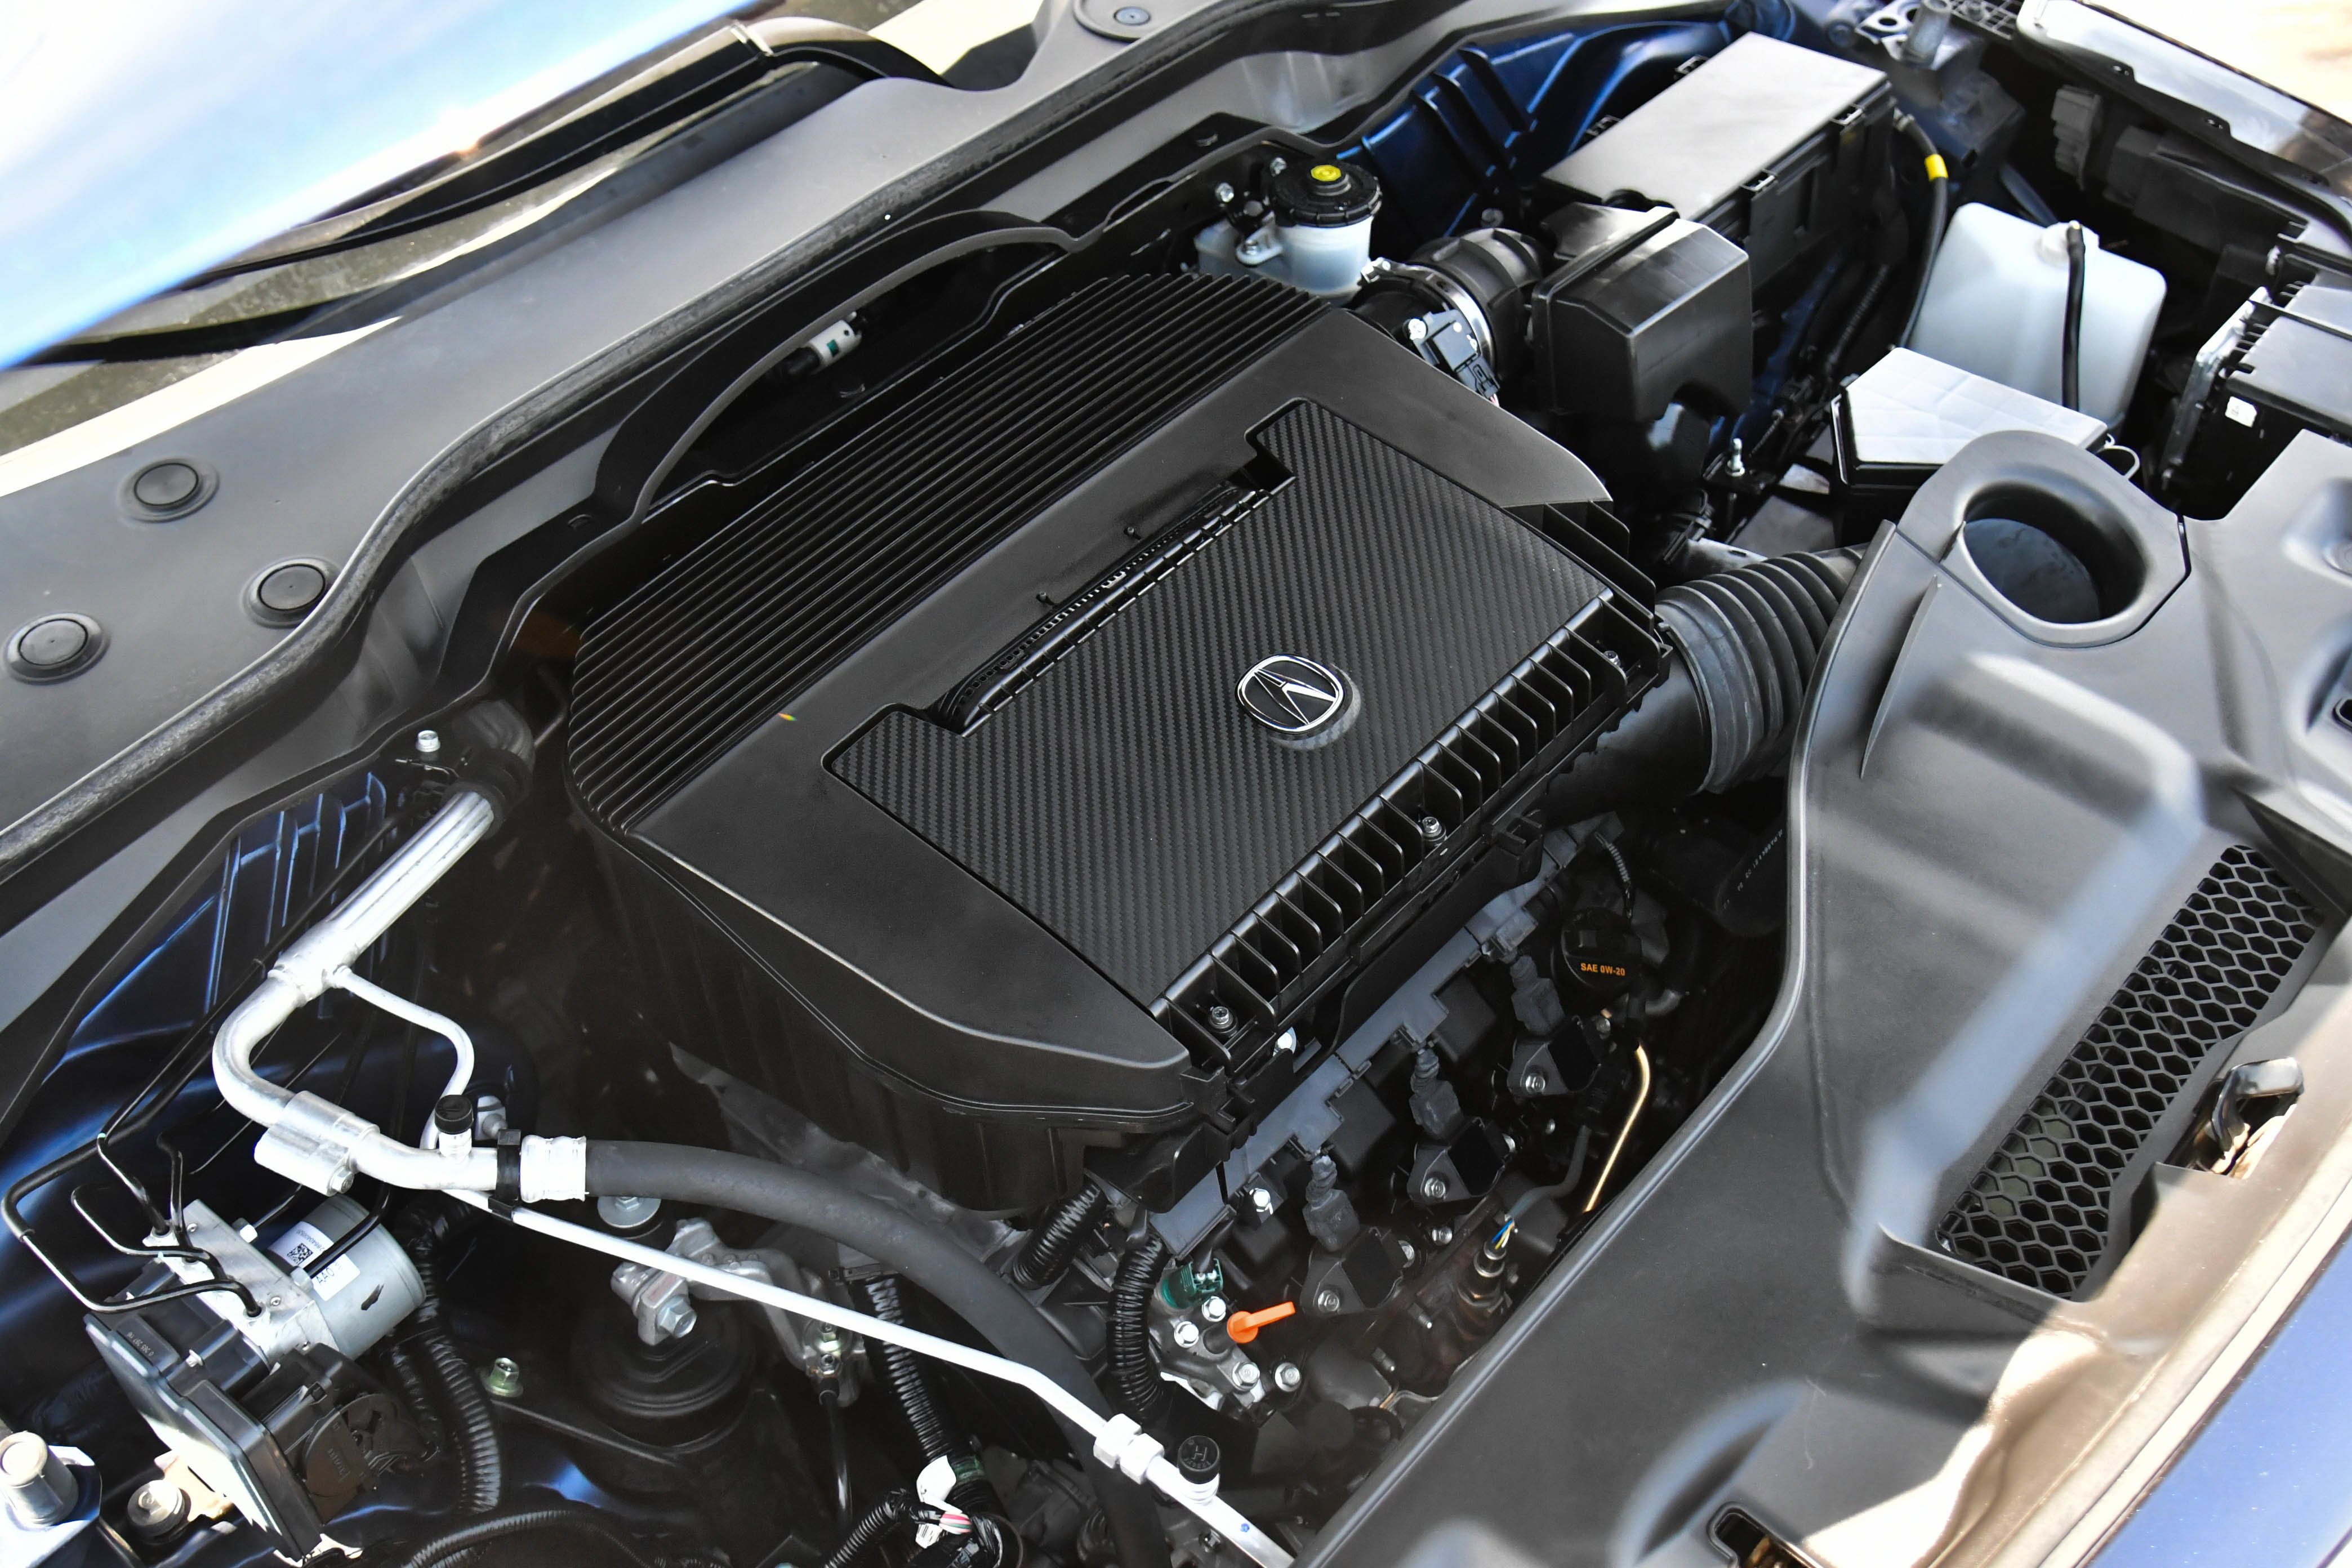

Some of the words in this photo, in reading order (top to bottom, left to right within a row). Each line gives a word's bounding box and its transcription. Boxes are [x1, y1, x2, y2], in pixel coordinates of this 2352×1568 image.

[1580, 963, 1598, 973] SAE
[1600, 965, 1625, 976] 0W-20
[1191, 1445, 1208, 1462] H
